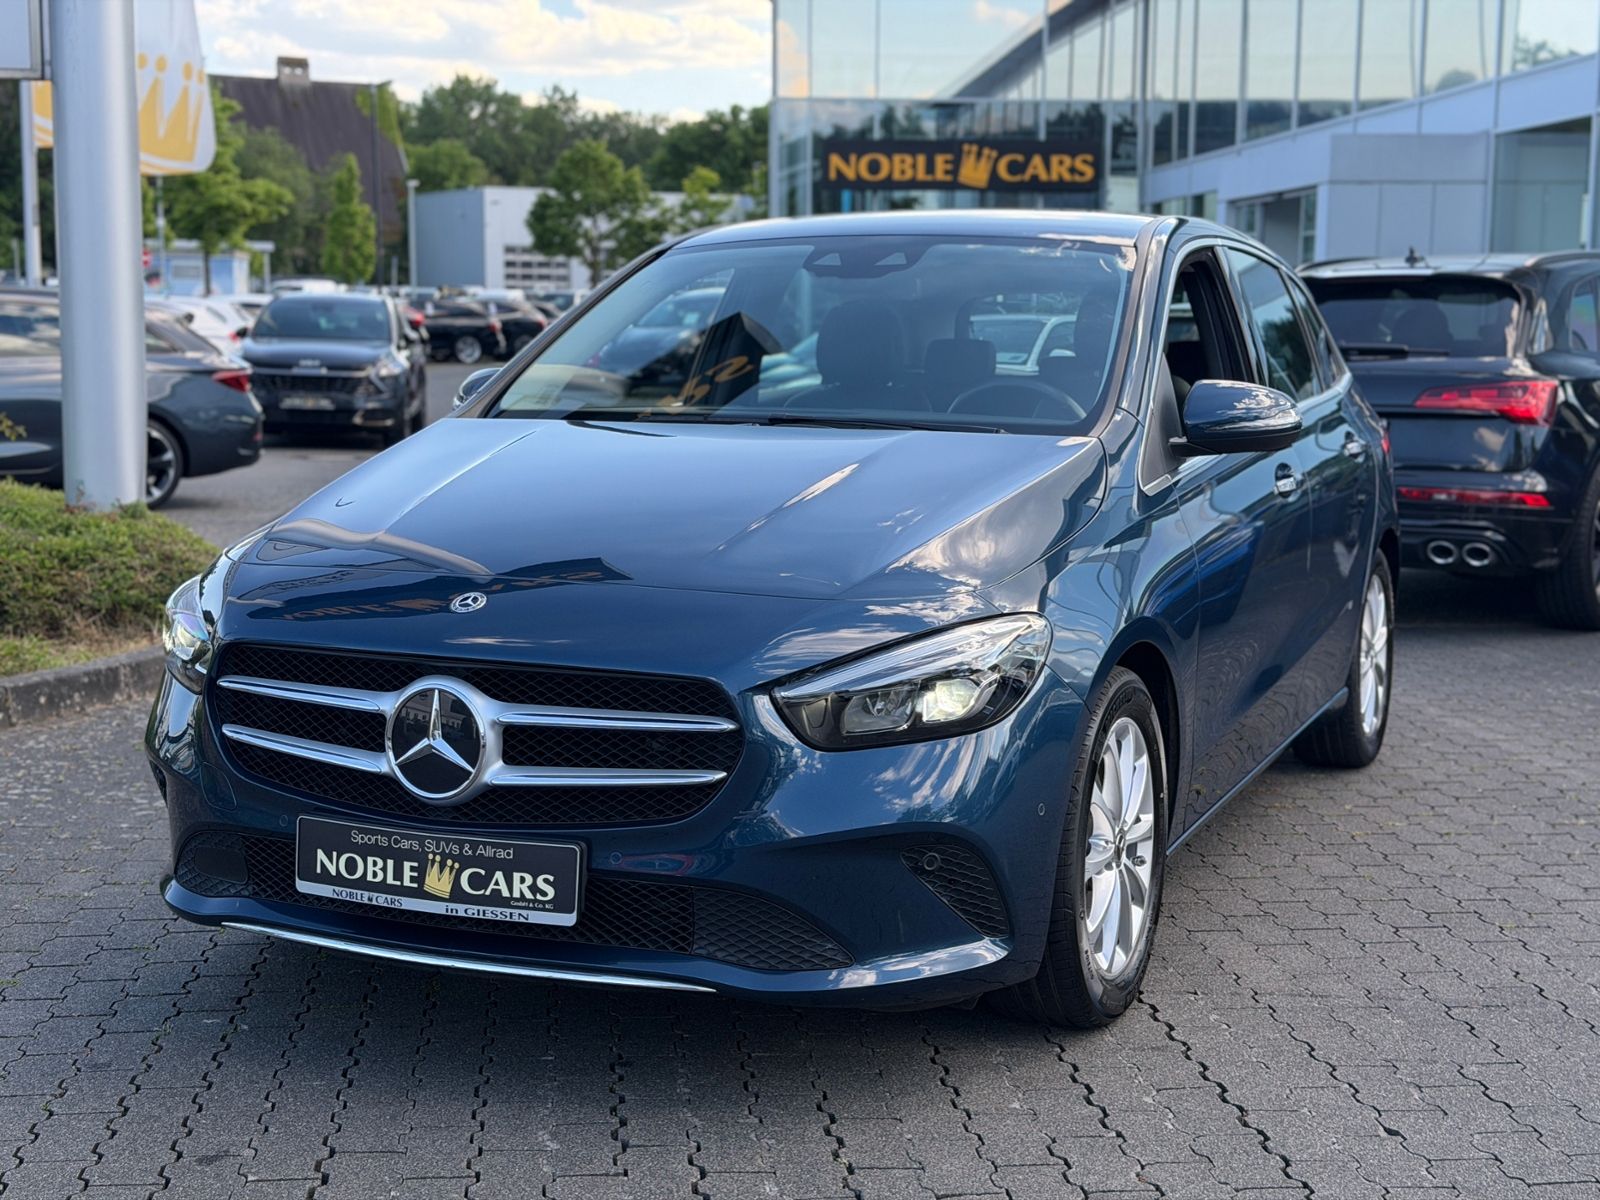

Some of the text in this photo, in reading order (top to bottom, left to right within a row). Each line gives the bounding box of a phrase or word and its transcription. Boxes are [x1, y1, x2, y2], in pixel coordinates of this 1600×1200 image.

[828, 153, 1095, 182] NOBLE CARS
[350, 830, 514, 859] Sports Cars, SUVs & Allrad
[316, 848, 556, 901] NOBLE CARS
[332, 888, 403, 908] NOBLE CARS
[445, 904, 529, 921] in GIESSEN
